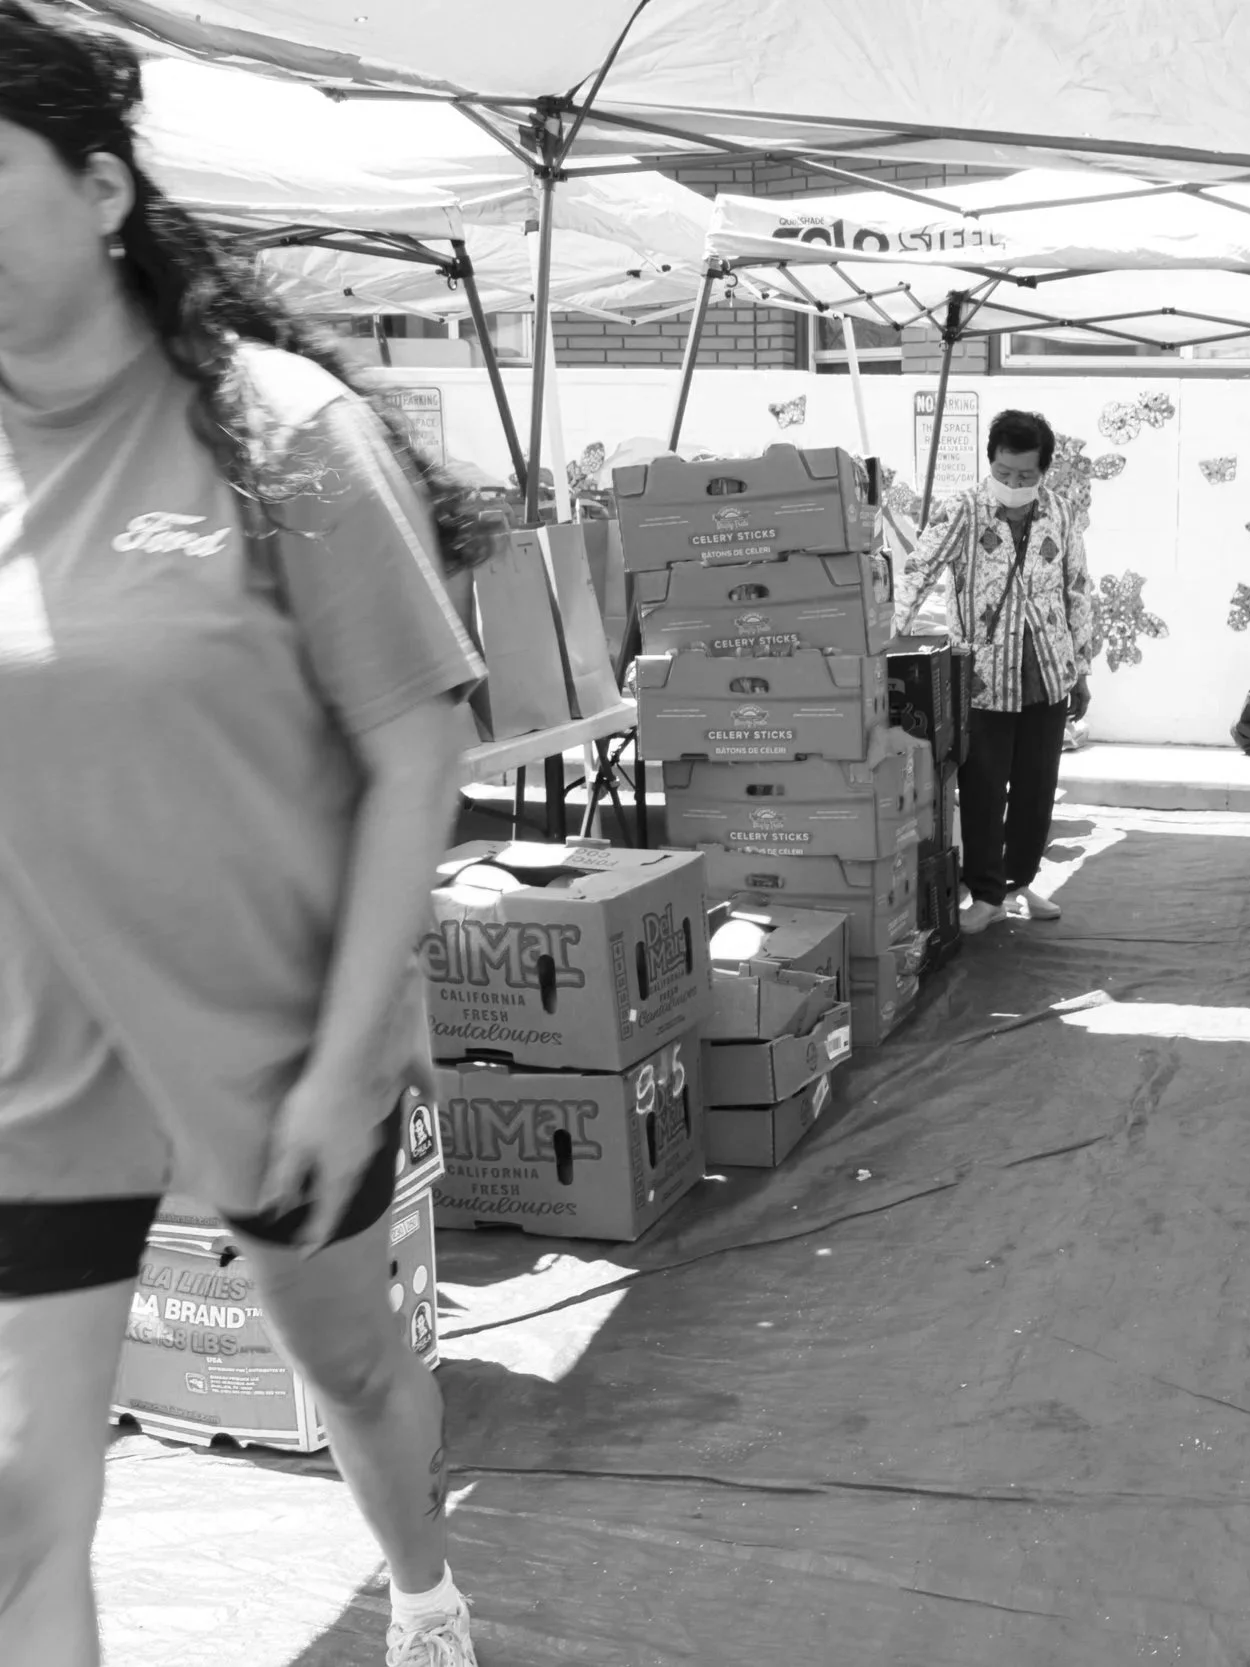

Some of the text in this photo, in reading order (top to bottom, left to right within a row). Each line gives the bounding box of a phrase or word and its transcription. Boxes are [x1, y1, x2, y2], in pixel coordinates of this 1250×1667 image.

[917, 396, 976, 413] NO ARKING
[944, 424, 972, 433] SPACE
[692, 528, 776, 545] CELERY STICKS
[715, 633, 798, 649] CELERY STICKS
[708, 729, 793, 741] CELERY STICKS
[730, 831, 809, 842] CELERY STICKS
[643, 902, 673, 949] Del
[441, 988, 526, 1006] CALIFORNIA
[463, 1008, 508, 1022] FRESH
[447, 1164, 540, 1180] CALIFORNIA
[471, 1183, 520, 1196] FRESH
[190, 1330, 238, 1356] LBS
[206, 1356, 223, 1364] USA
